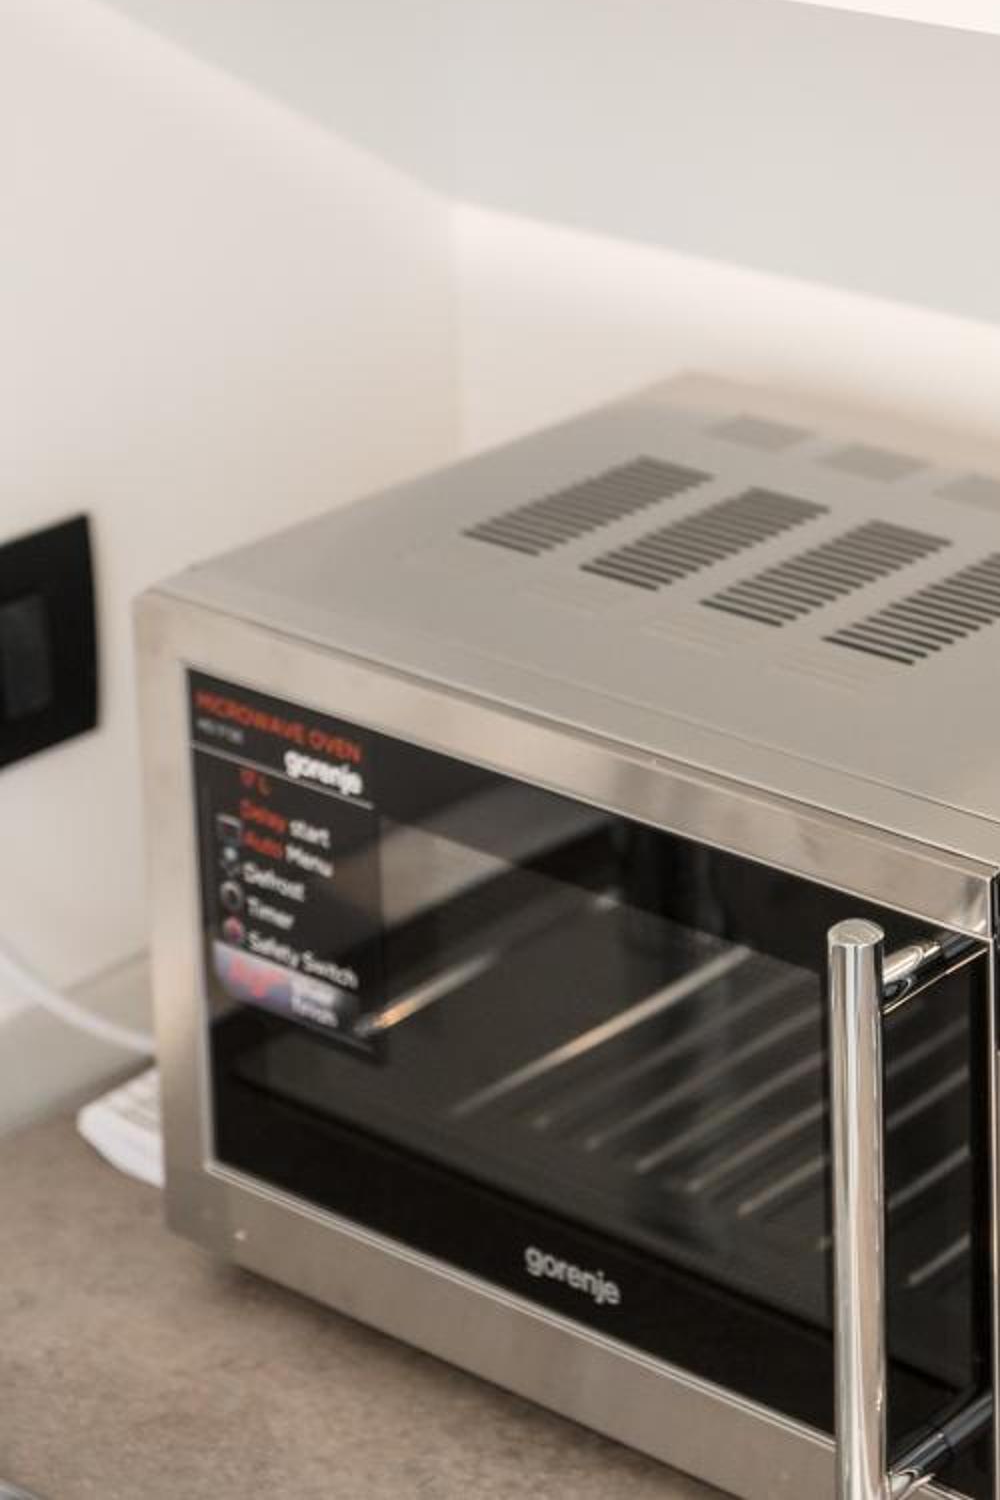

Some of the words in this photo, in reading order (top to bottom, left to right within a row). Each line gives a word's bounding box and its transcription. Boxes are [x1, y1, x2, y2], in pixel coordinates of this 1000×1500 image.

[195, 691, 305, 744] MICROWAVE
[309, 728, 362, 764] OVEN
[284, 749, 363, 796] gorenje
[243, 862, 305, 902] Defrost
[286, 843, 334, 878] Menu
[247, 896, 296, 930] Timer
[248, 931, 300, 969] Safety
[301, 950, 360, 990] Switch
[524, 1246, 621, 1305] gorenje
